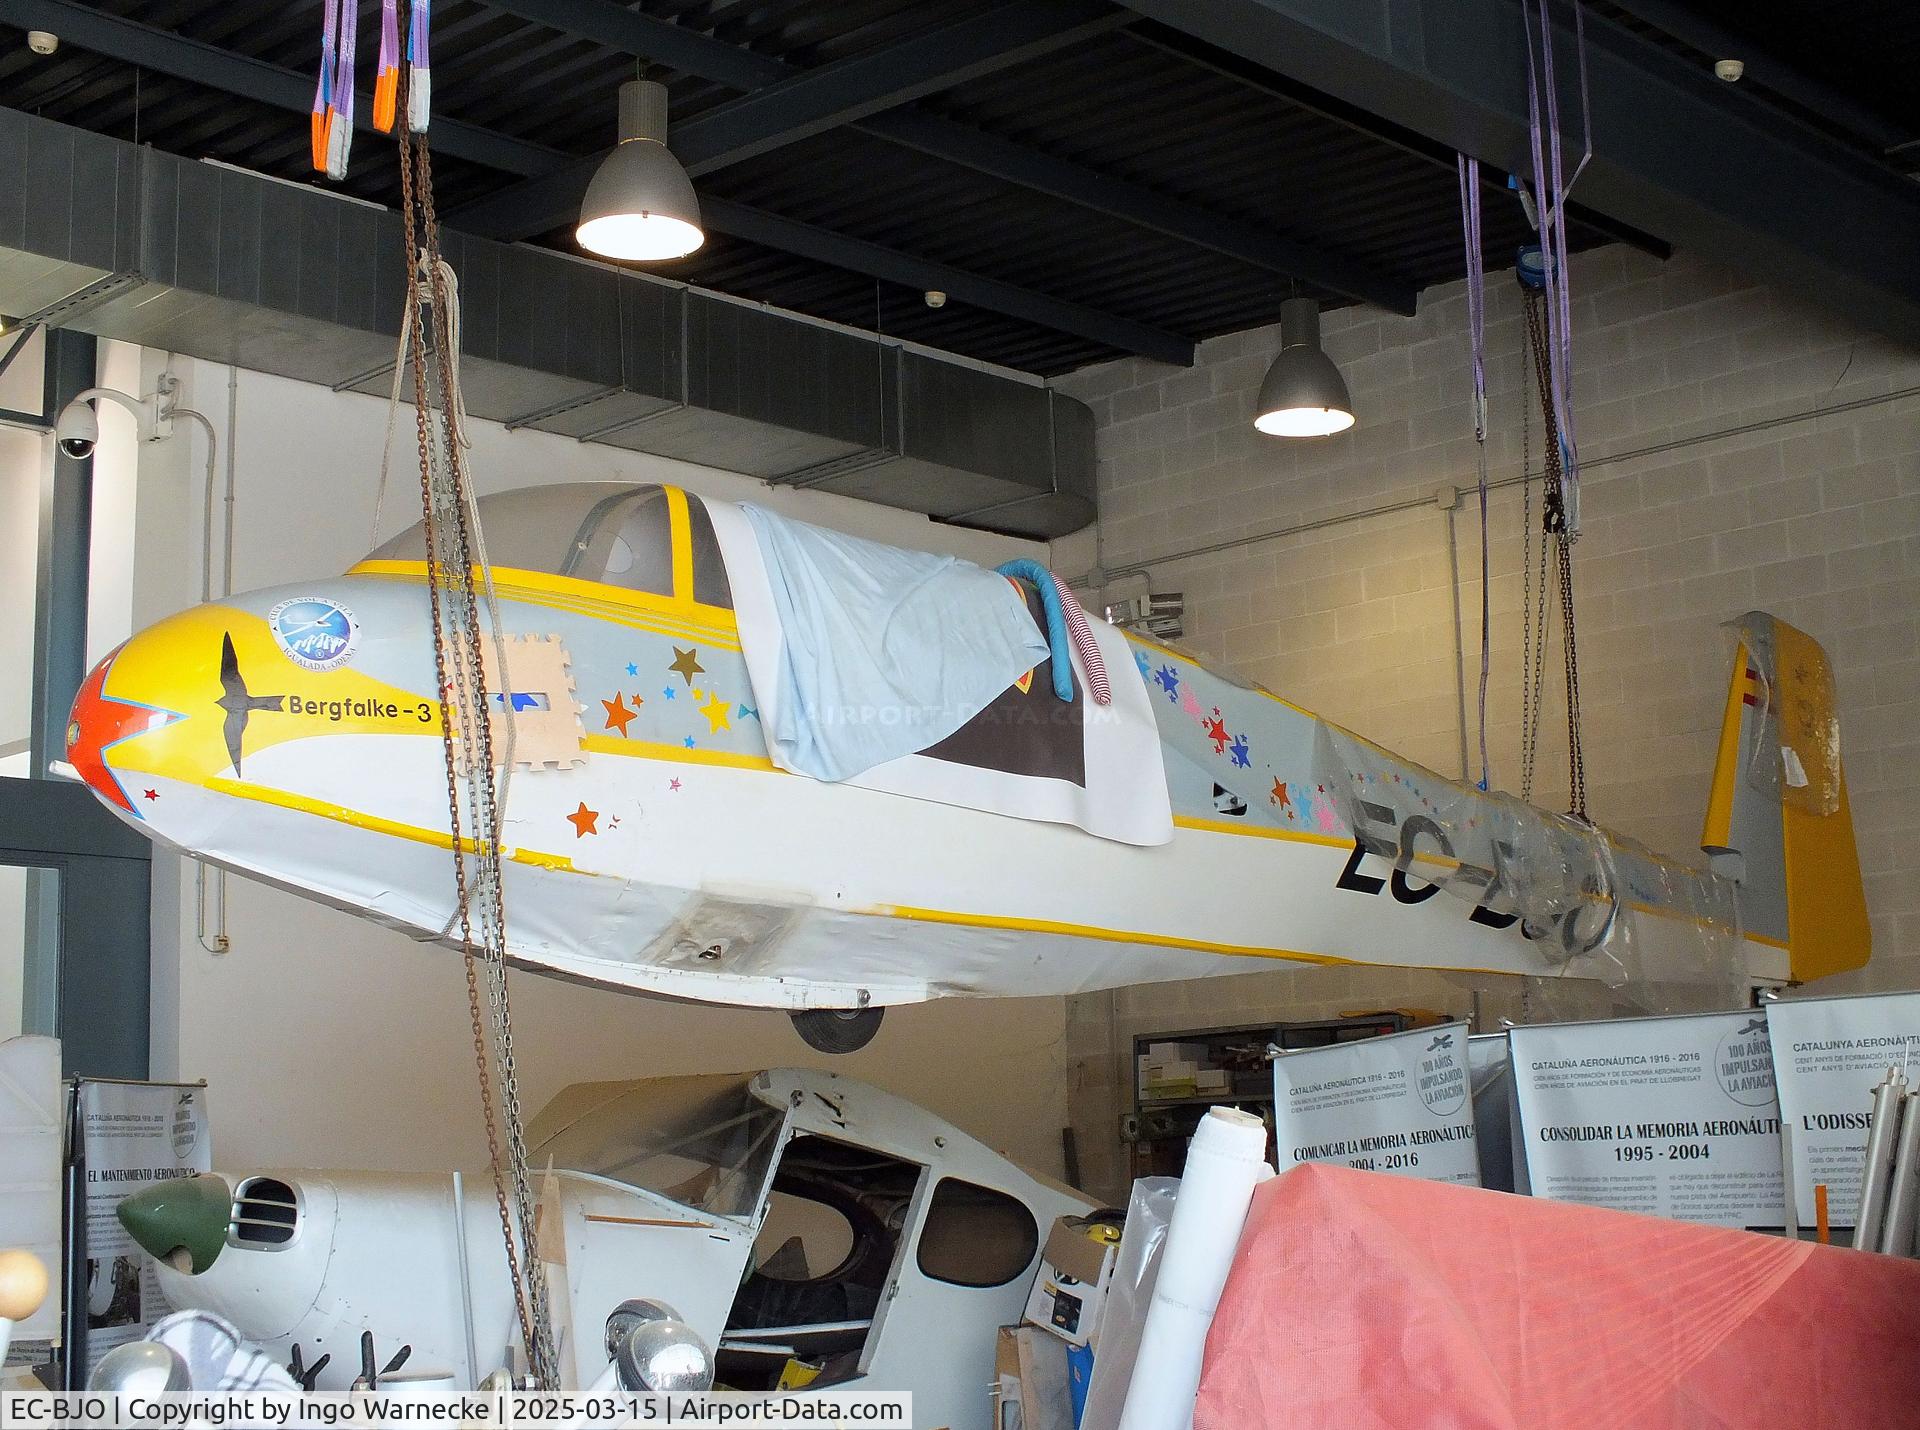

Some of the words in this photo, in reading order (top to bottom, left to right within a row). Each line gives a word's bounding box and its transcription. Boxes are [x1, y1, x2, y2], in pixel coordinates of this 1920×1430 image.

[1728, 1044, 1745, 1058] 100
[1793, 1040, 1855, 1052] CATALUNYA
[1532, 1058, 1578, 1071] CATALUÑA
[1678, 1052, 1701, 1062] 2016
[1796, 1065, 1818, 1074] CENT
[1821, 1064, 1844, 1072] ANYS
[1540, 1124, 1613, 1142] CONSOLIDAR
[1617, 1124, 1633, 1140] LA
[1636, 1122, 1699, 1139] MEMORIA
[1293, 1141, 1346, 1161] COMUNICAR
[1347, 1139, 1358, 1154] LA
[1360, 1133, 1407, 1151] MEMORIA
[1614, 1146, 1654, 1162] 1995
[1668, 1143, 1710, 1160] 2004
[1385, 1151, 1419, 1169] 2016
[88, 1170, 99, 1182] EL
